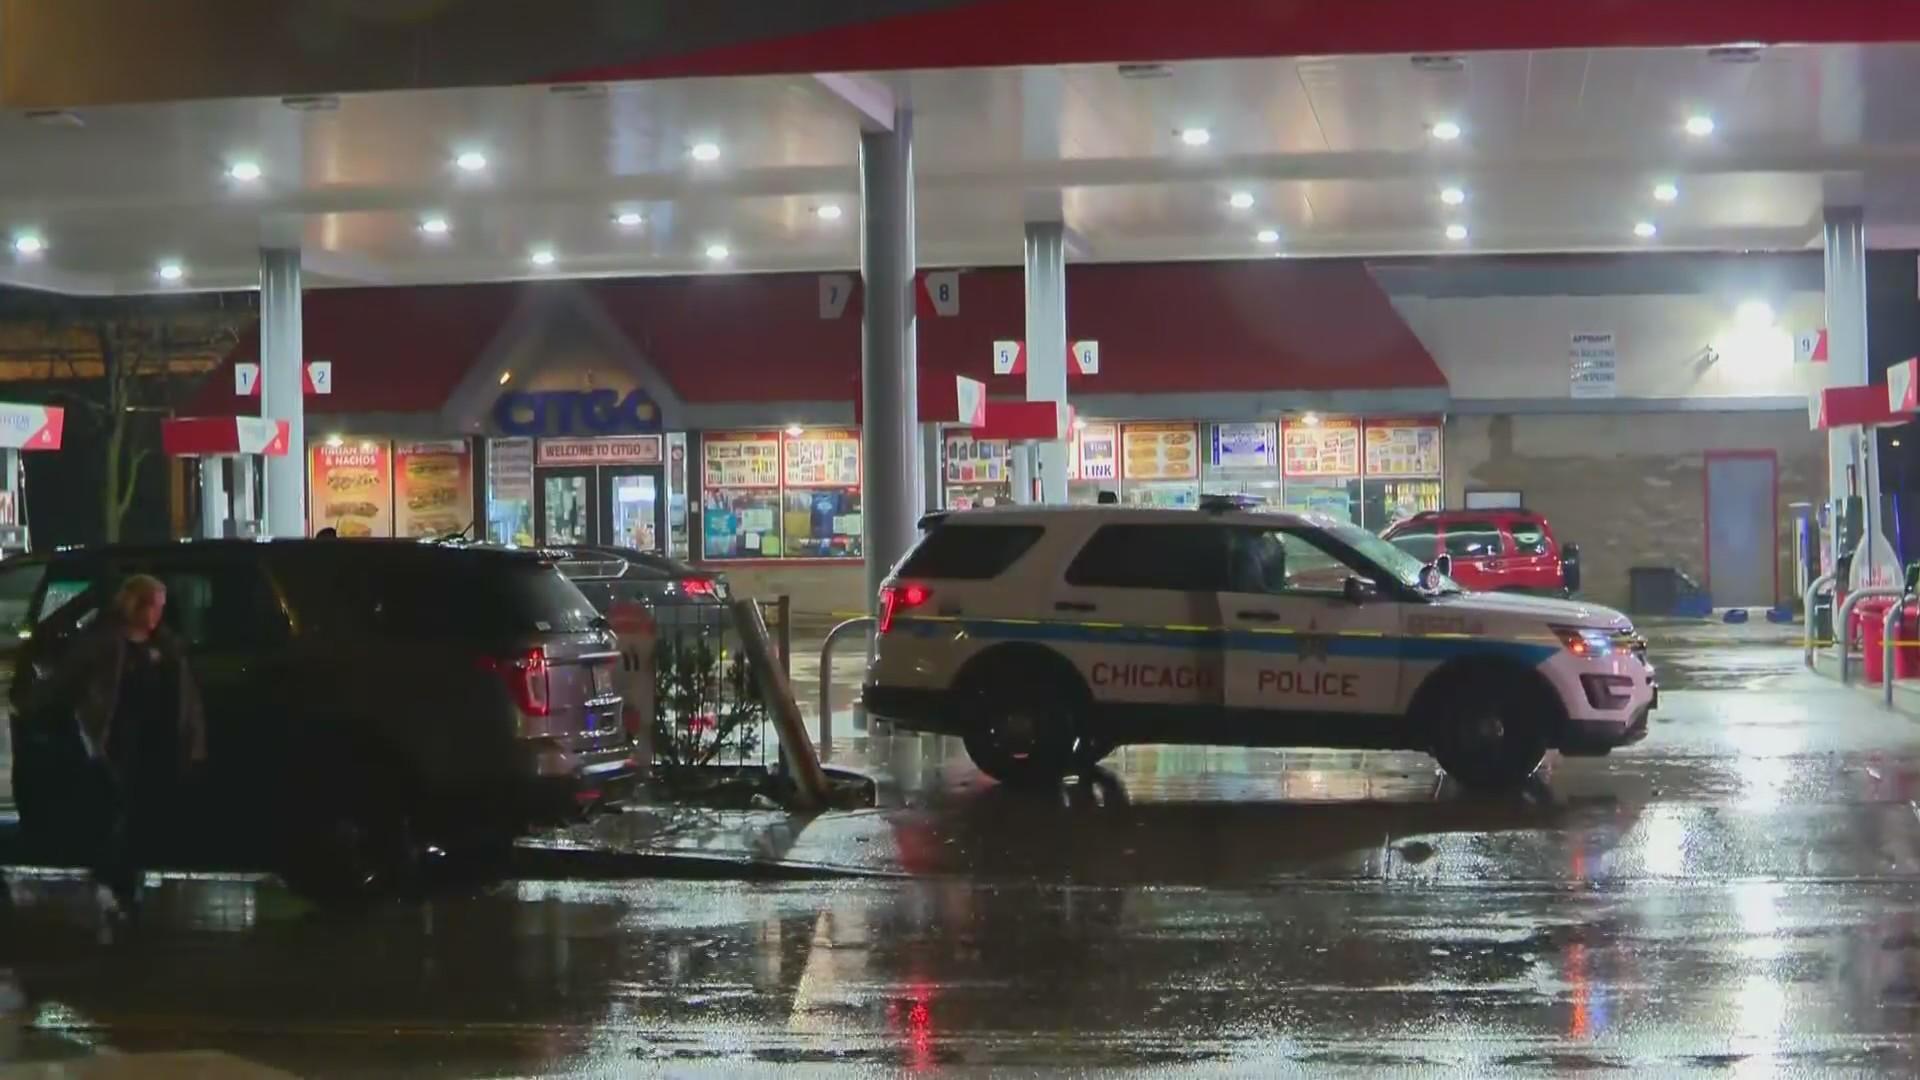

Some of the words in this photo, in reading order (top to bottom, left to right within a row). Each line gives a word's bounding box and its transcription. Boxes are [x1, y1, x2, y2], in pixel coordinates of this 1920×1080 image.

[939, 284, 949, 302] 8
[1802, 338, 1810, 352] 9
[1001, 350, 1008, 363] 5
[1083, 350, 1091, 363] 6
[318, 370, 325, 384] 2
[494, 390, 662, 434] CITGO
[545, 444, 594, 458] WELCOME
[596, 444, 608, 456] TO
[611, 443, 641, 456] CITGO
[335, 455, 376, 466] NACHOS
[1085, 464, 1111, 477] LINK
[1091, 661, 1214, 689] CHICAGO
[1258, 668, 1360, 697] POLICE
